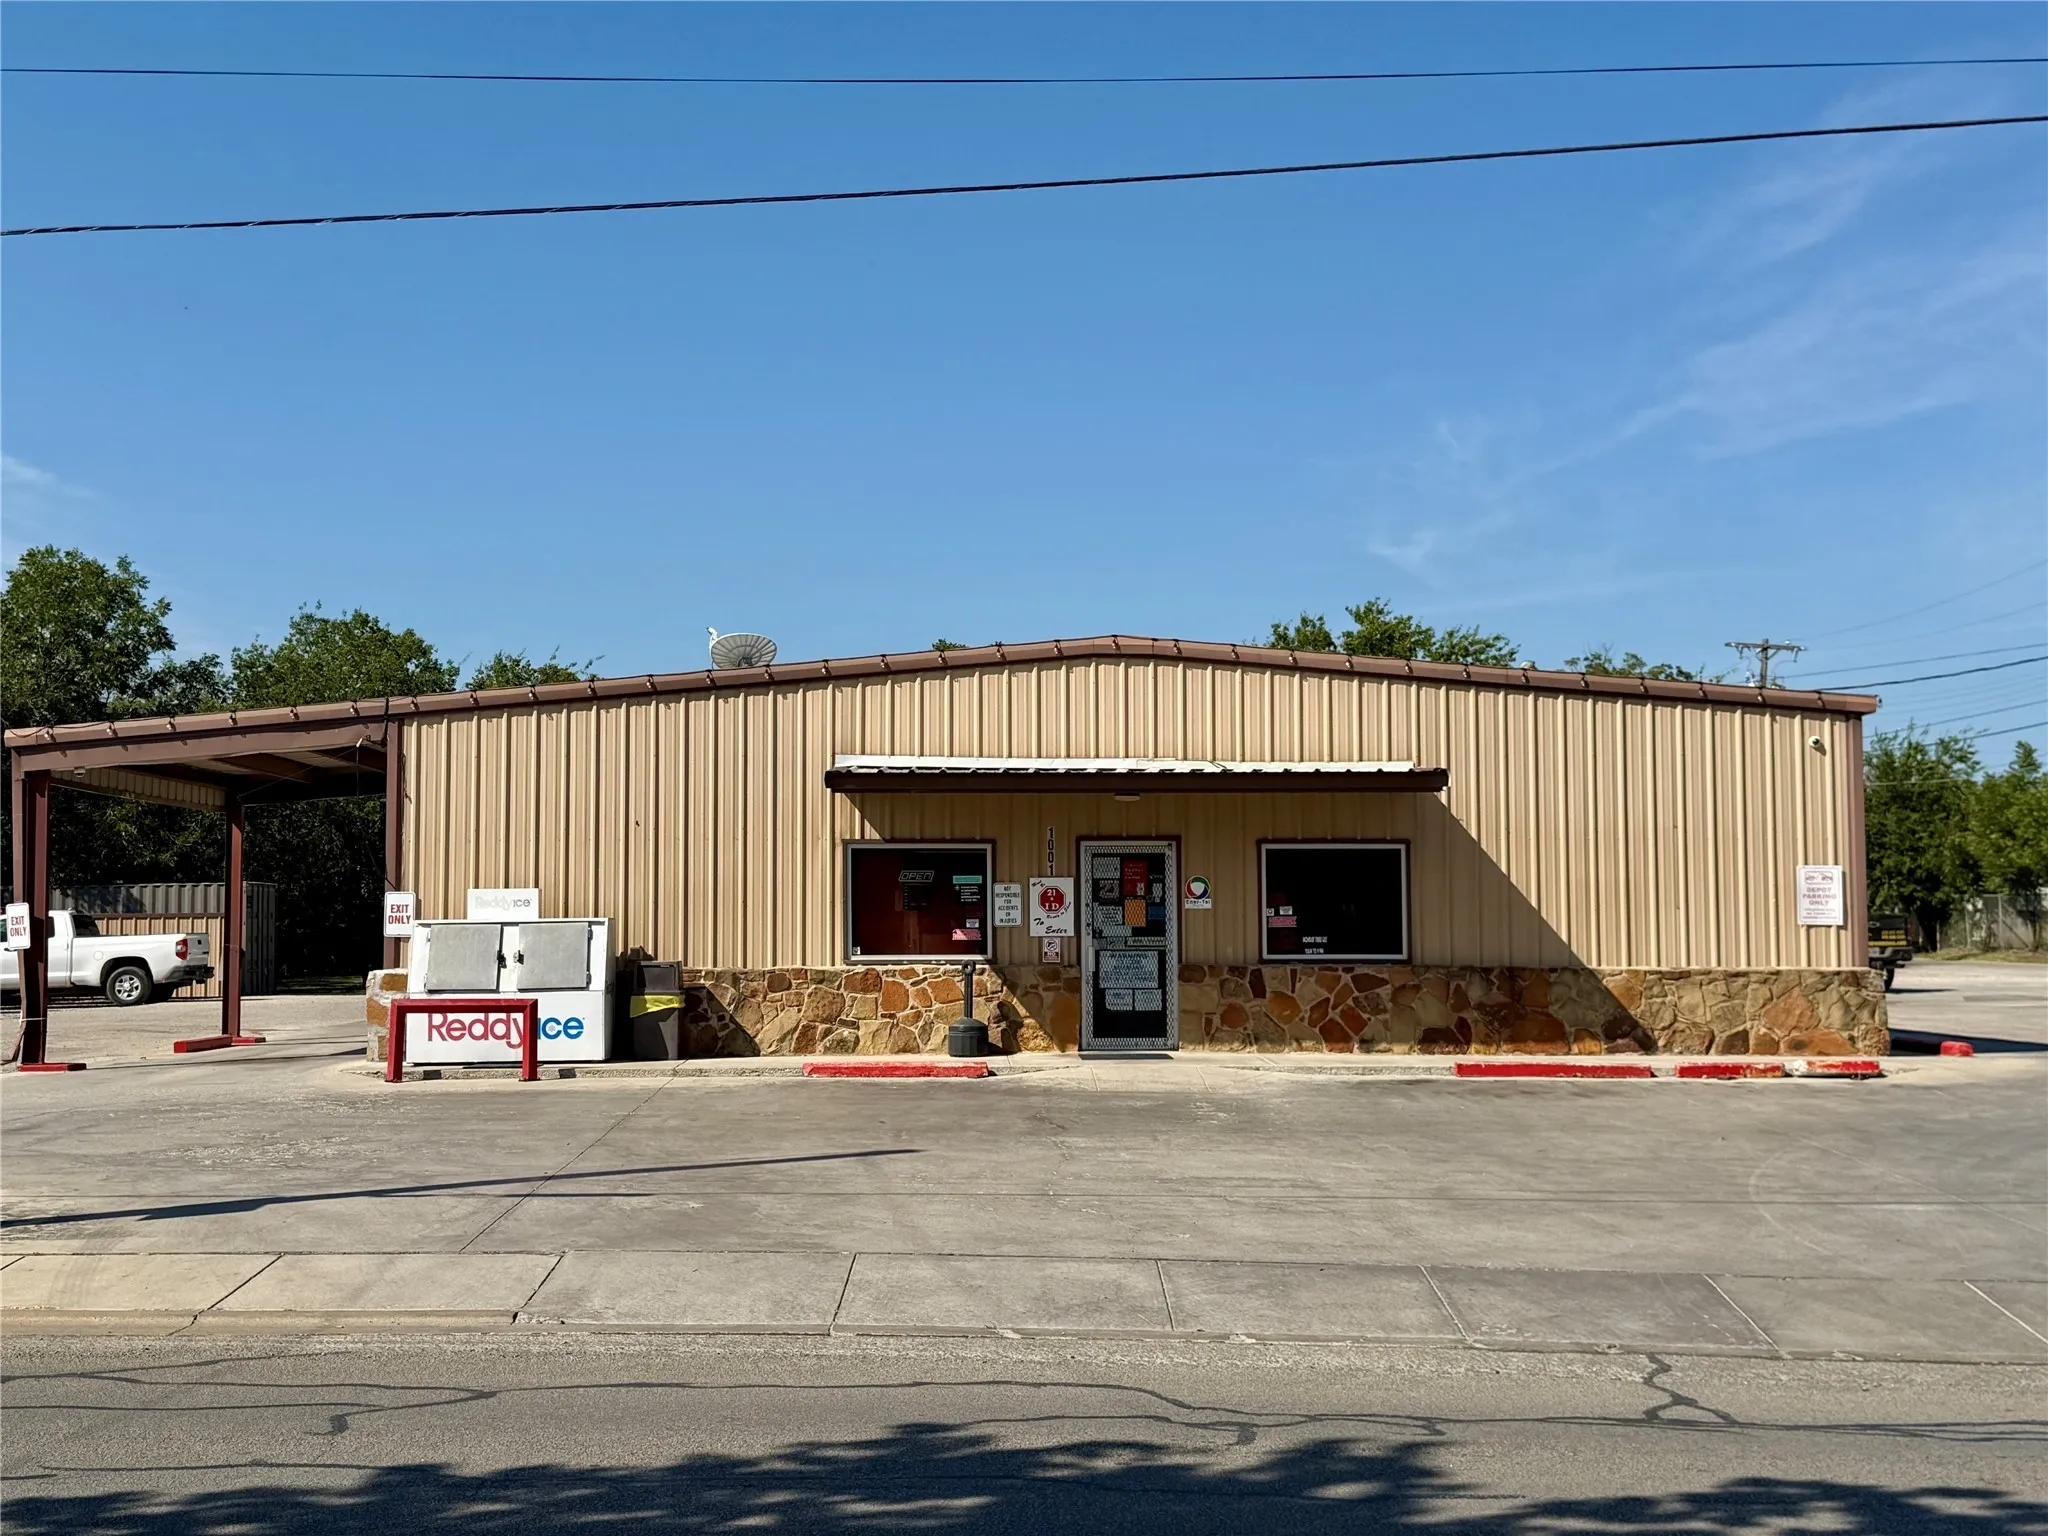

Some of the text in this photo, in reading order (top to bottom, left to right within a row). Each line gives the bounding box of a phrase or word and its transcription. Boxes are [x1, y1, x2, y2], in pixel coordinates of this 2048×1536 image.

[1047, 826, 1055, 876] 1001
[901, 872, 932, 880] OPEN
[1046, 889, 1056, 897] 21
[390, 904, 409, 914] EXIT
[10, 916, 25, 926] EXIT
[388, 915, 411, 925] ONLY
[1033, 917, 1045, 926] To
[10, 927, 27, 937] ONLY
[1045, 925, 1067, 935] Enter
